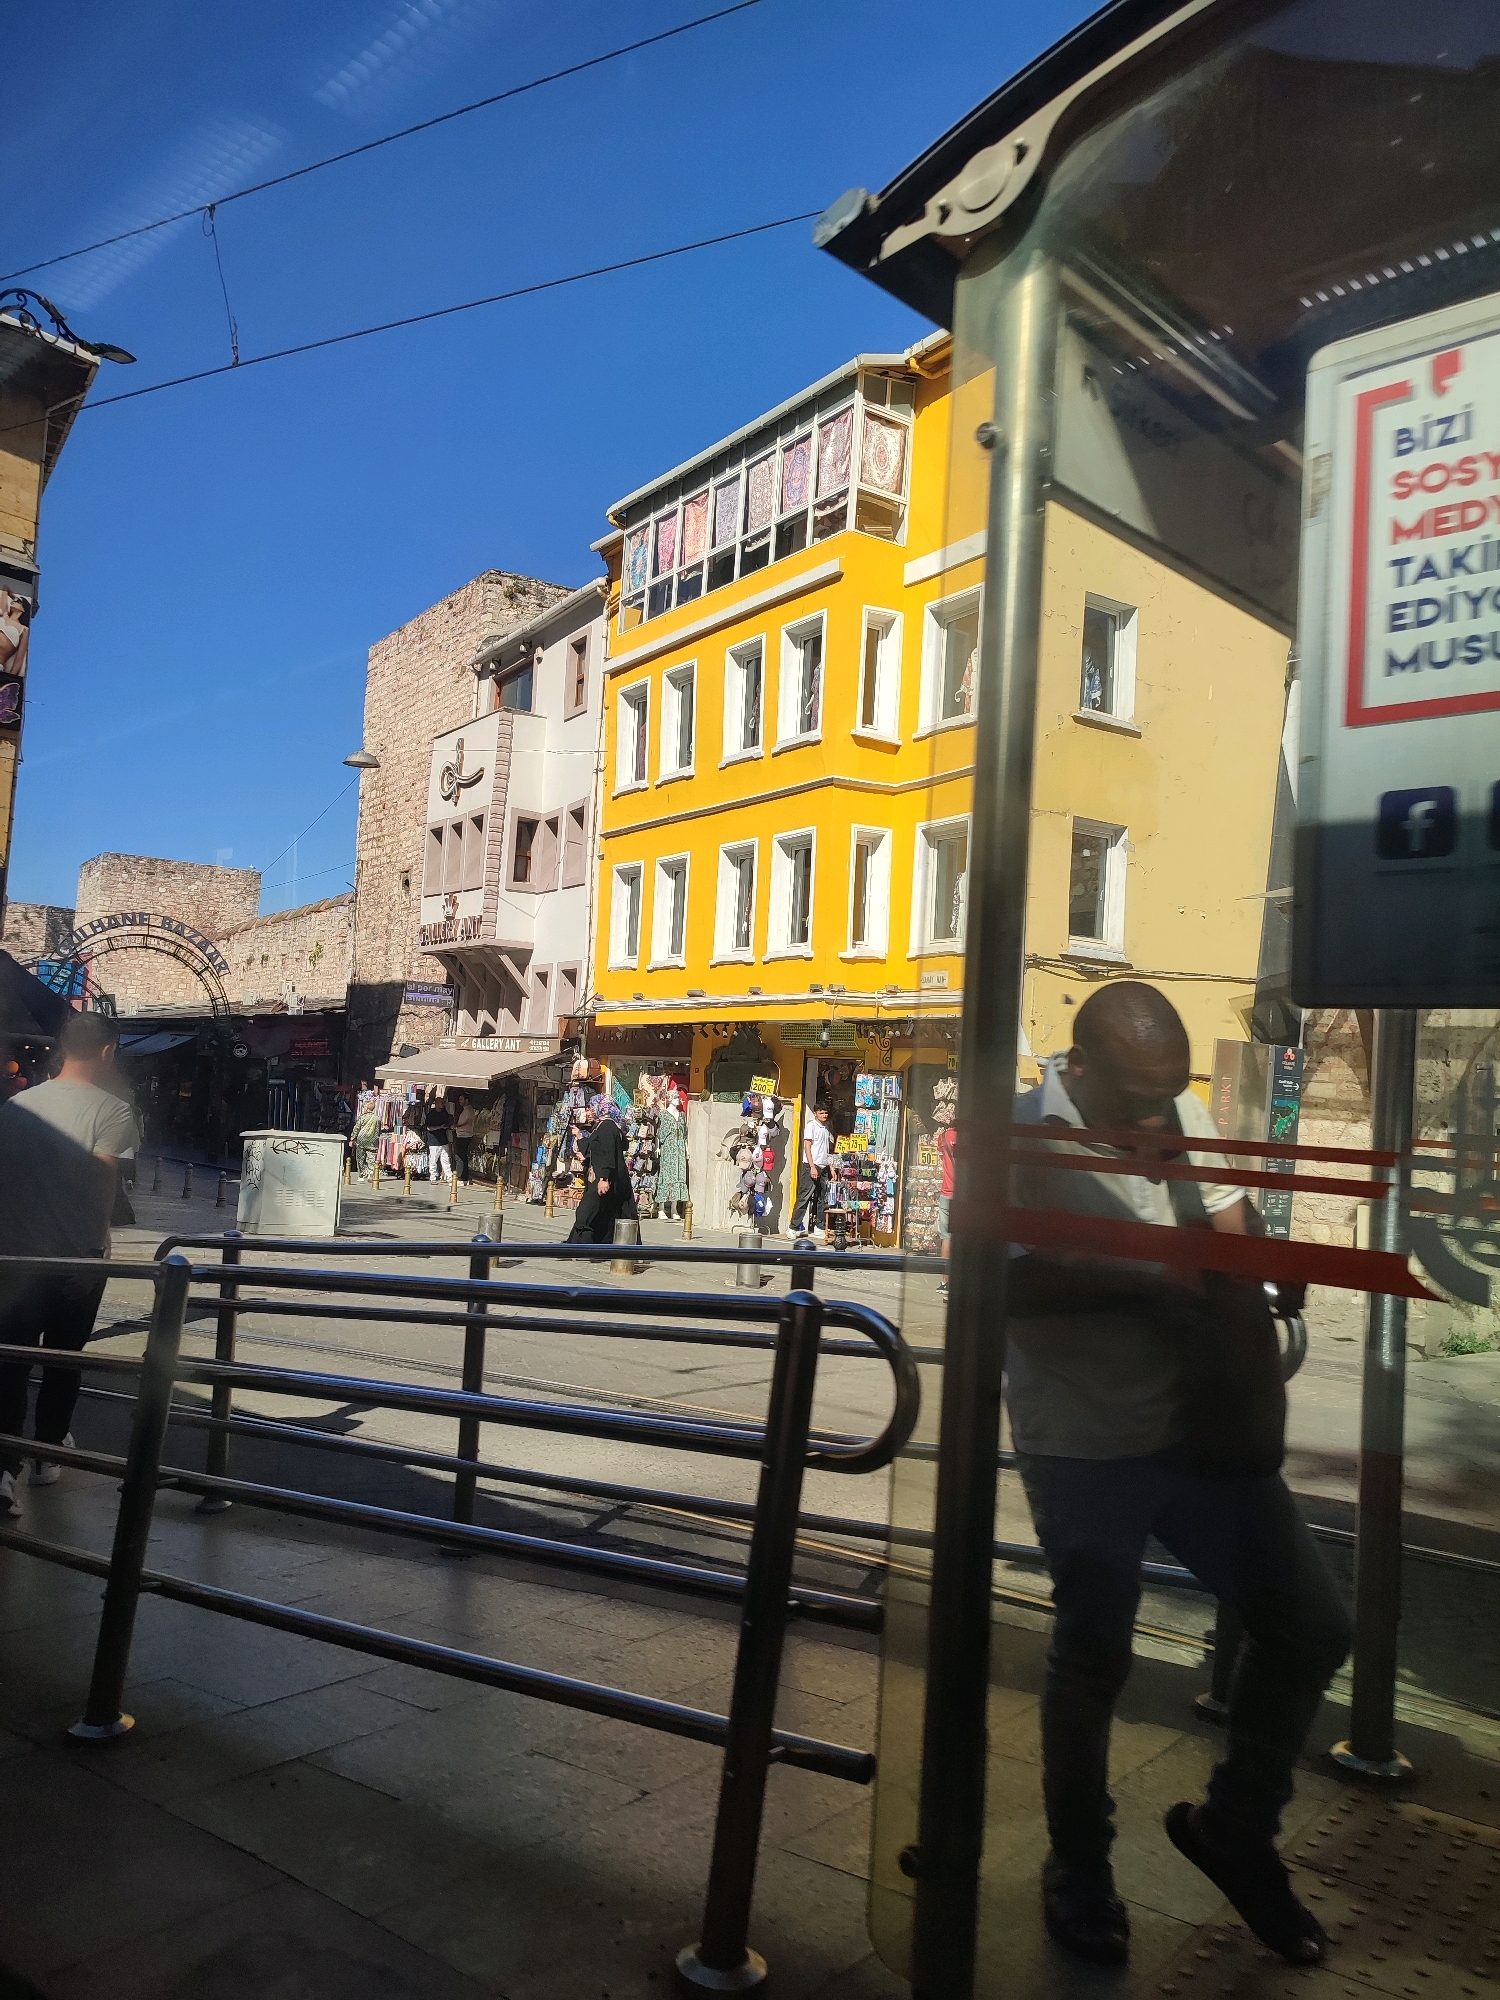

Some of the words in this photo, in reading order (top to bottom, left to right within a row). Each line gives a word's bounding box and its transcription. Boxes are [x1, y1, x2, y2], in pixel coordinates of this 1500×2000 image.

[1391, 401, 1474, 458] BİZİ
[1387, 533, 1500, 588] TAKİ
[160, 916, 229, 976] BAZAAR
[472, 1038, 504, 1050] GALLERY
[504, 1039, 521, 1051] ANT
[753, 1083, 767, 1093] 200
[1218, 1076, 1233, 1125] PARKI
[921, 1152, 932, 1165] 50
